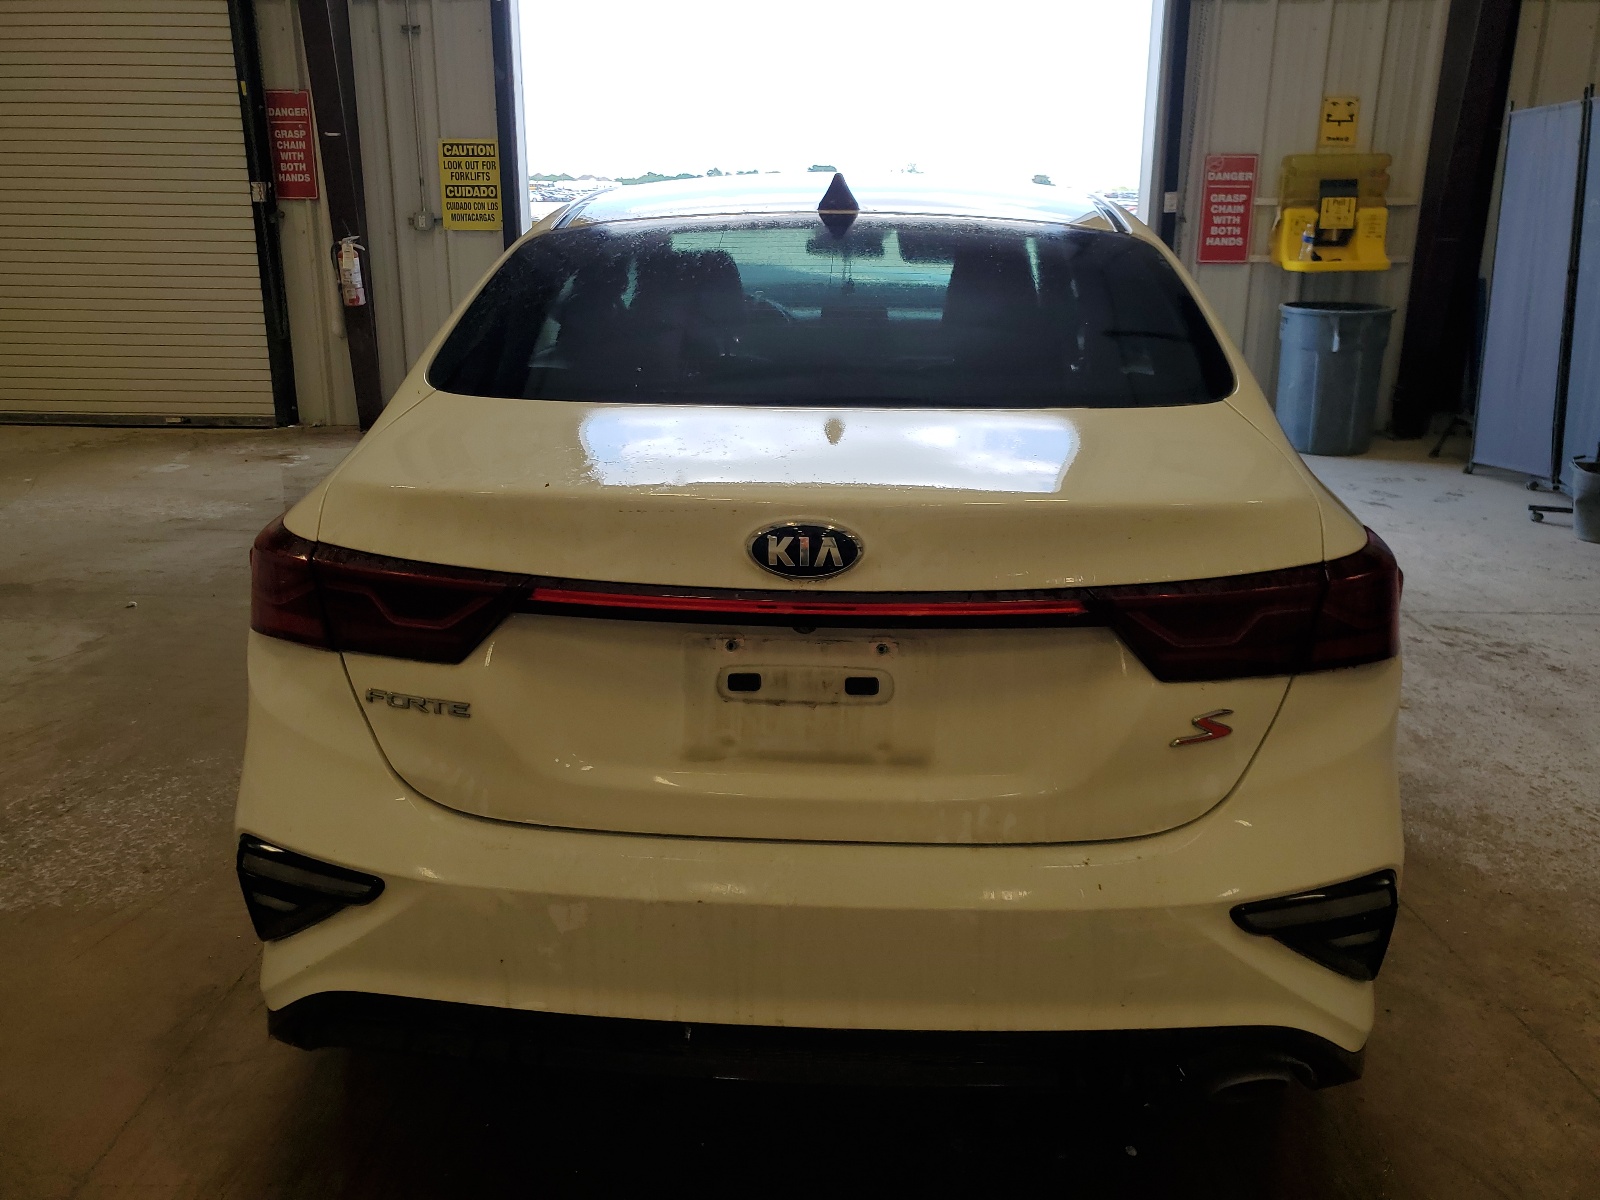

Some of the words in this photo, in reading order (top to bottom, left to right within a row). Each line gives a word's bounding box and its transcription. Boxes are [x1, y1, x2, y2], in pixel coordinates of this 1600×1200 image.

[268, 107, 308, 117] DANGER
[274, 130, 306, 139] GRASP
[276, 141, 306, 150] CHAIN
[443, 144, 495, 156] CAUTION
[280, 152, 304, 161] WITH
[280, 163, 306, 171] BOTH
[443, 160, 463, 170] LOOK
[465, 160, 480, 170] OUT
[482, 160, 497, 170] FOR
[279, 173, 311, 182] HANDS
[450, 171, 491, 181] FORKLIFTS
[1207, 171, 1253, 181] DANGER
[446, 186, 497, 197] CUIDADO
[1210, 193, 1247, 203] GRASP
[446, 201, 472, 211] CUIDADO
[473, 201, 486, 211] CON
[487, 201, 499, 211] LOS
[1210, 204, 1245, 214] CHAIN
[450, 213, 496, 222] MONTACARGAS
[1212, 215, 1240, 225] WITH
[1210, 226, 1241, 235] BOTH
[1205, 237, 1244, 246] HANDS
[766, 534, 844, 567] KIA
[365, 687, 471, 718] FORTE
[1169, 708, 1234, 748] S
